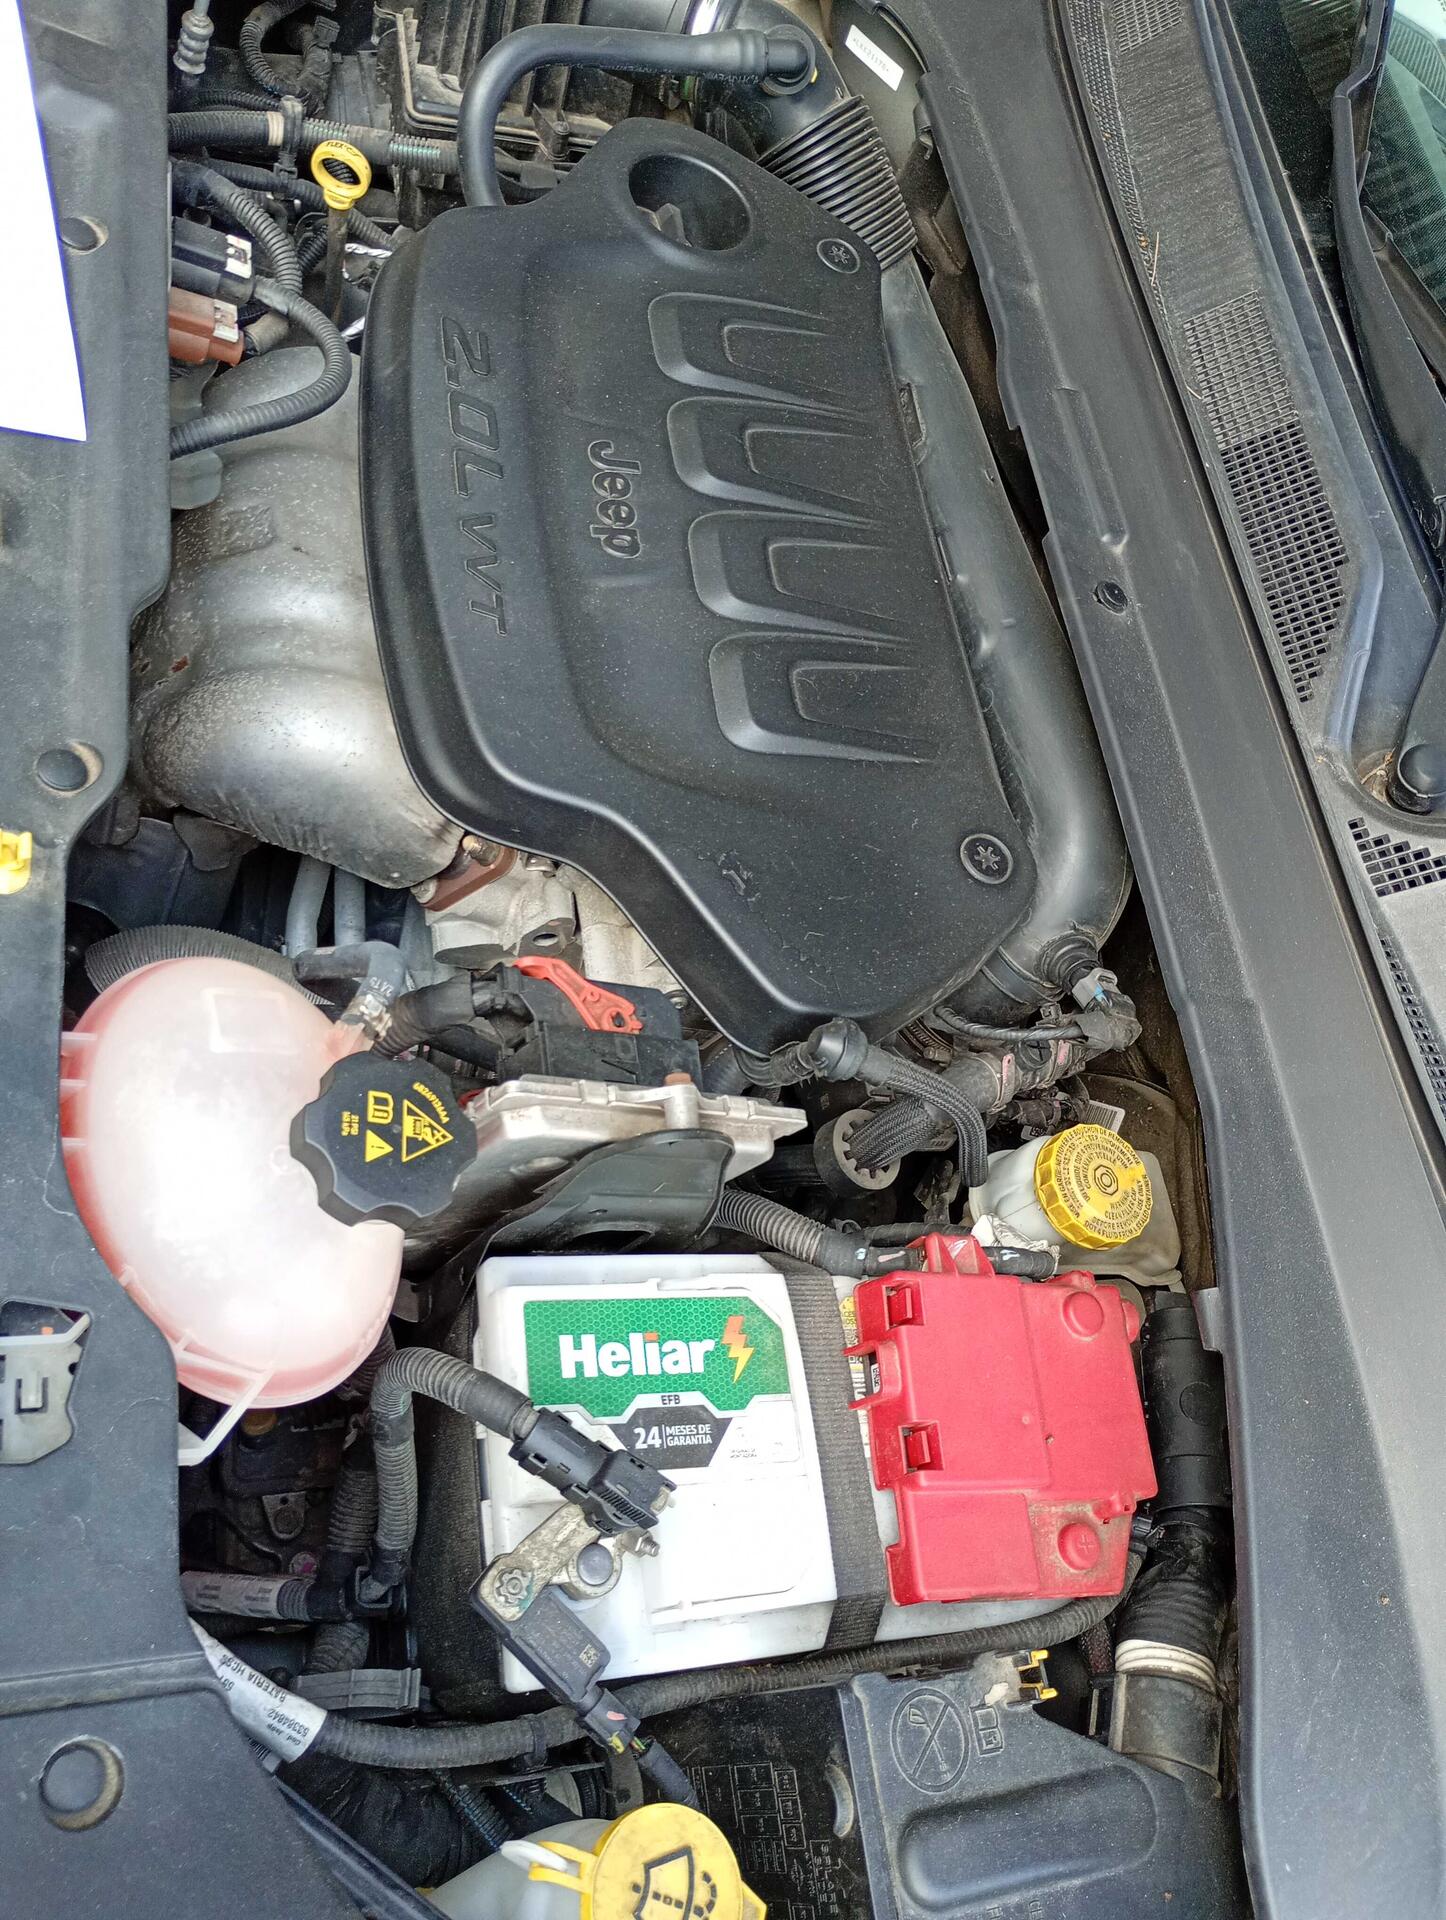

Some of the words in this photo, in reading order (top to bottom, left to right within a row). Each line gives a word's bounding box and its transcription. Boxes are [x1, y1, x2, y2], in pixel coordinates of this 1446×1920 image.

[441, 316, 503, 497] 2.0L
[588, 440, 642, 558] Jeep
[460, 513, 507, 637] VVT
[559, 1332, 715, 1379] Heliar
[661, 1394, 681, 1406] EFB
[633, 1426, 662, 1449] 24
[666, 1425, 697, 1435] MESES
[698, 1424, 712, 1434] DE
[666, 1435, 713, 1447] GARANTIA
